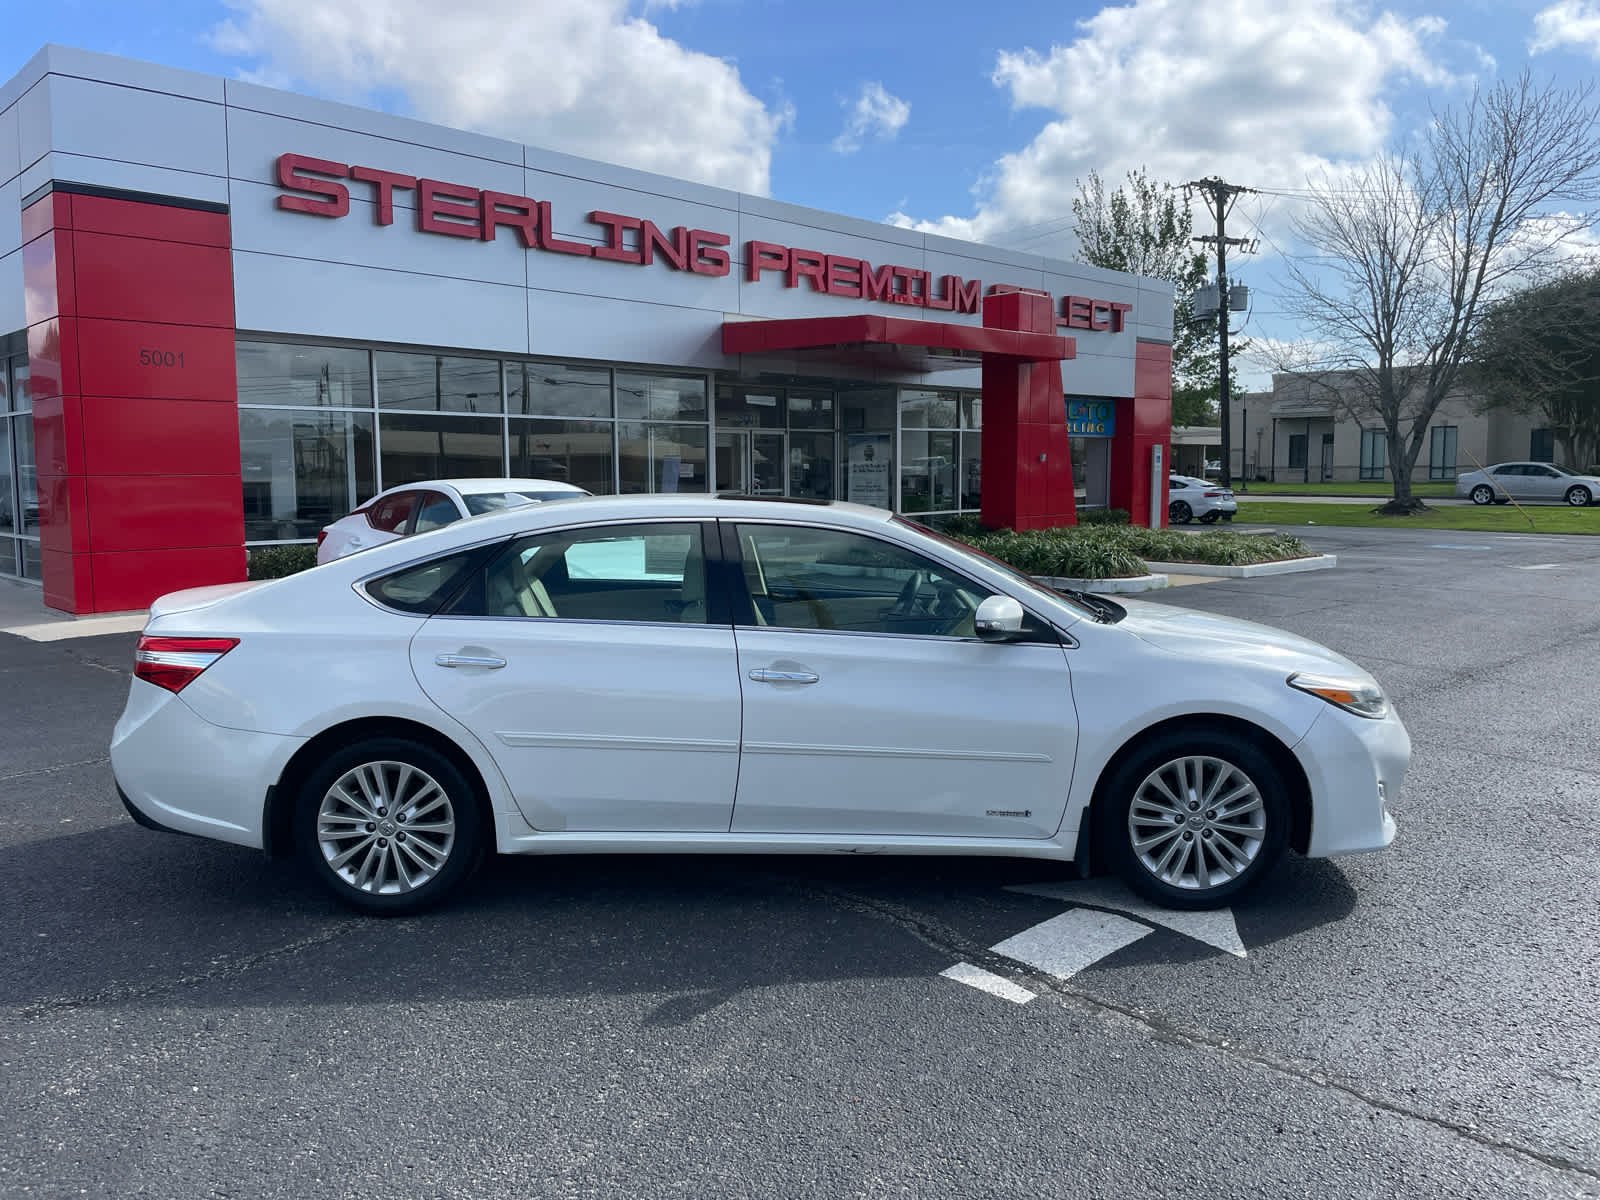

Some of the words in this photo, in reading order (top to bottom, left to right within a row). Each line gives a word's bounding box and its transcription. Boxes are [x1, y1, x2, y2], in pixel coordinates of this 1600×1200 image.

[276, 152, 730, 276] STERLING
[746, 240, 981, 314] PREMIUM
[140, 349, 185, 369] 5001
